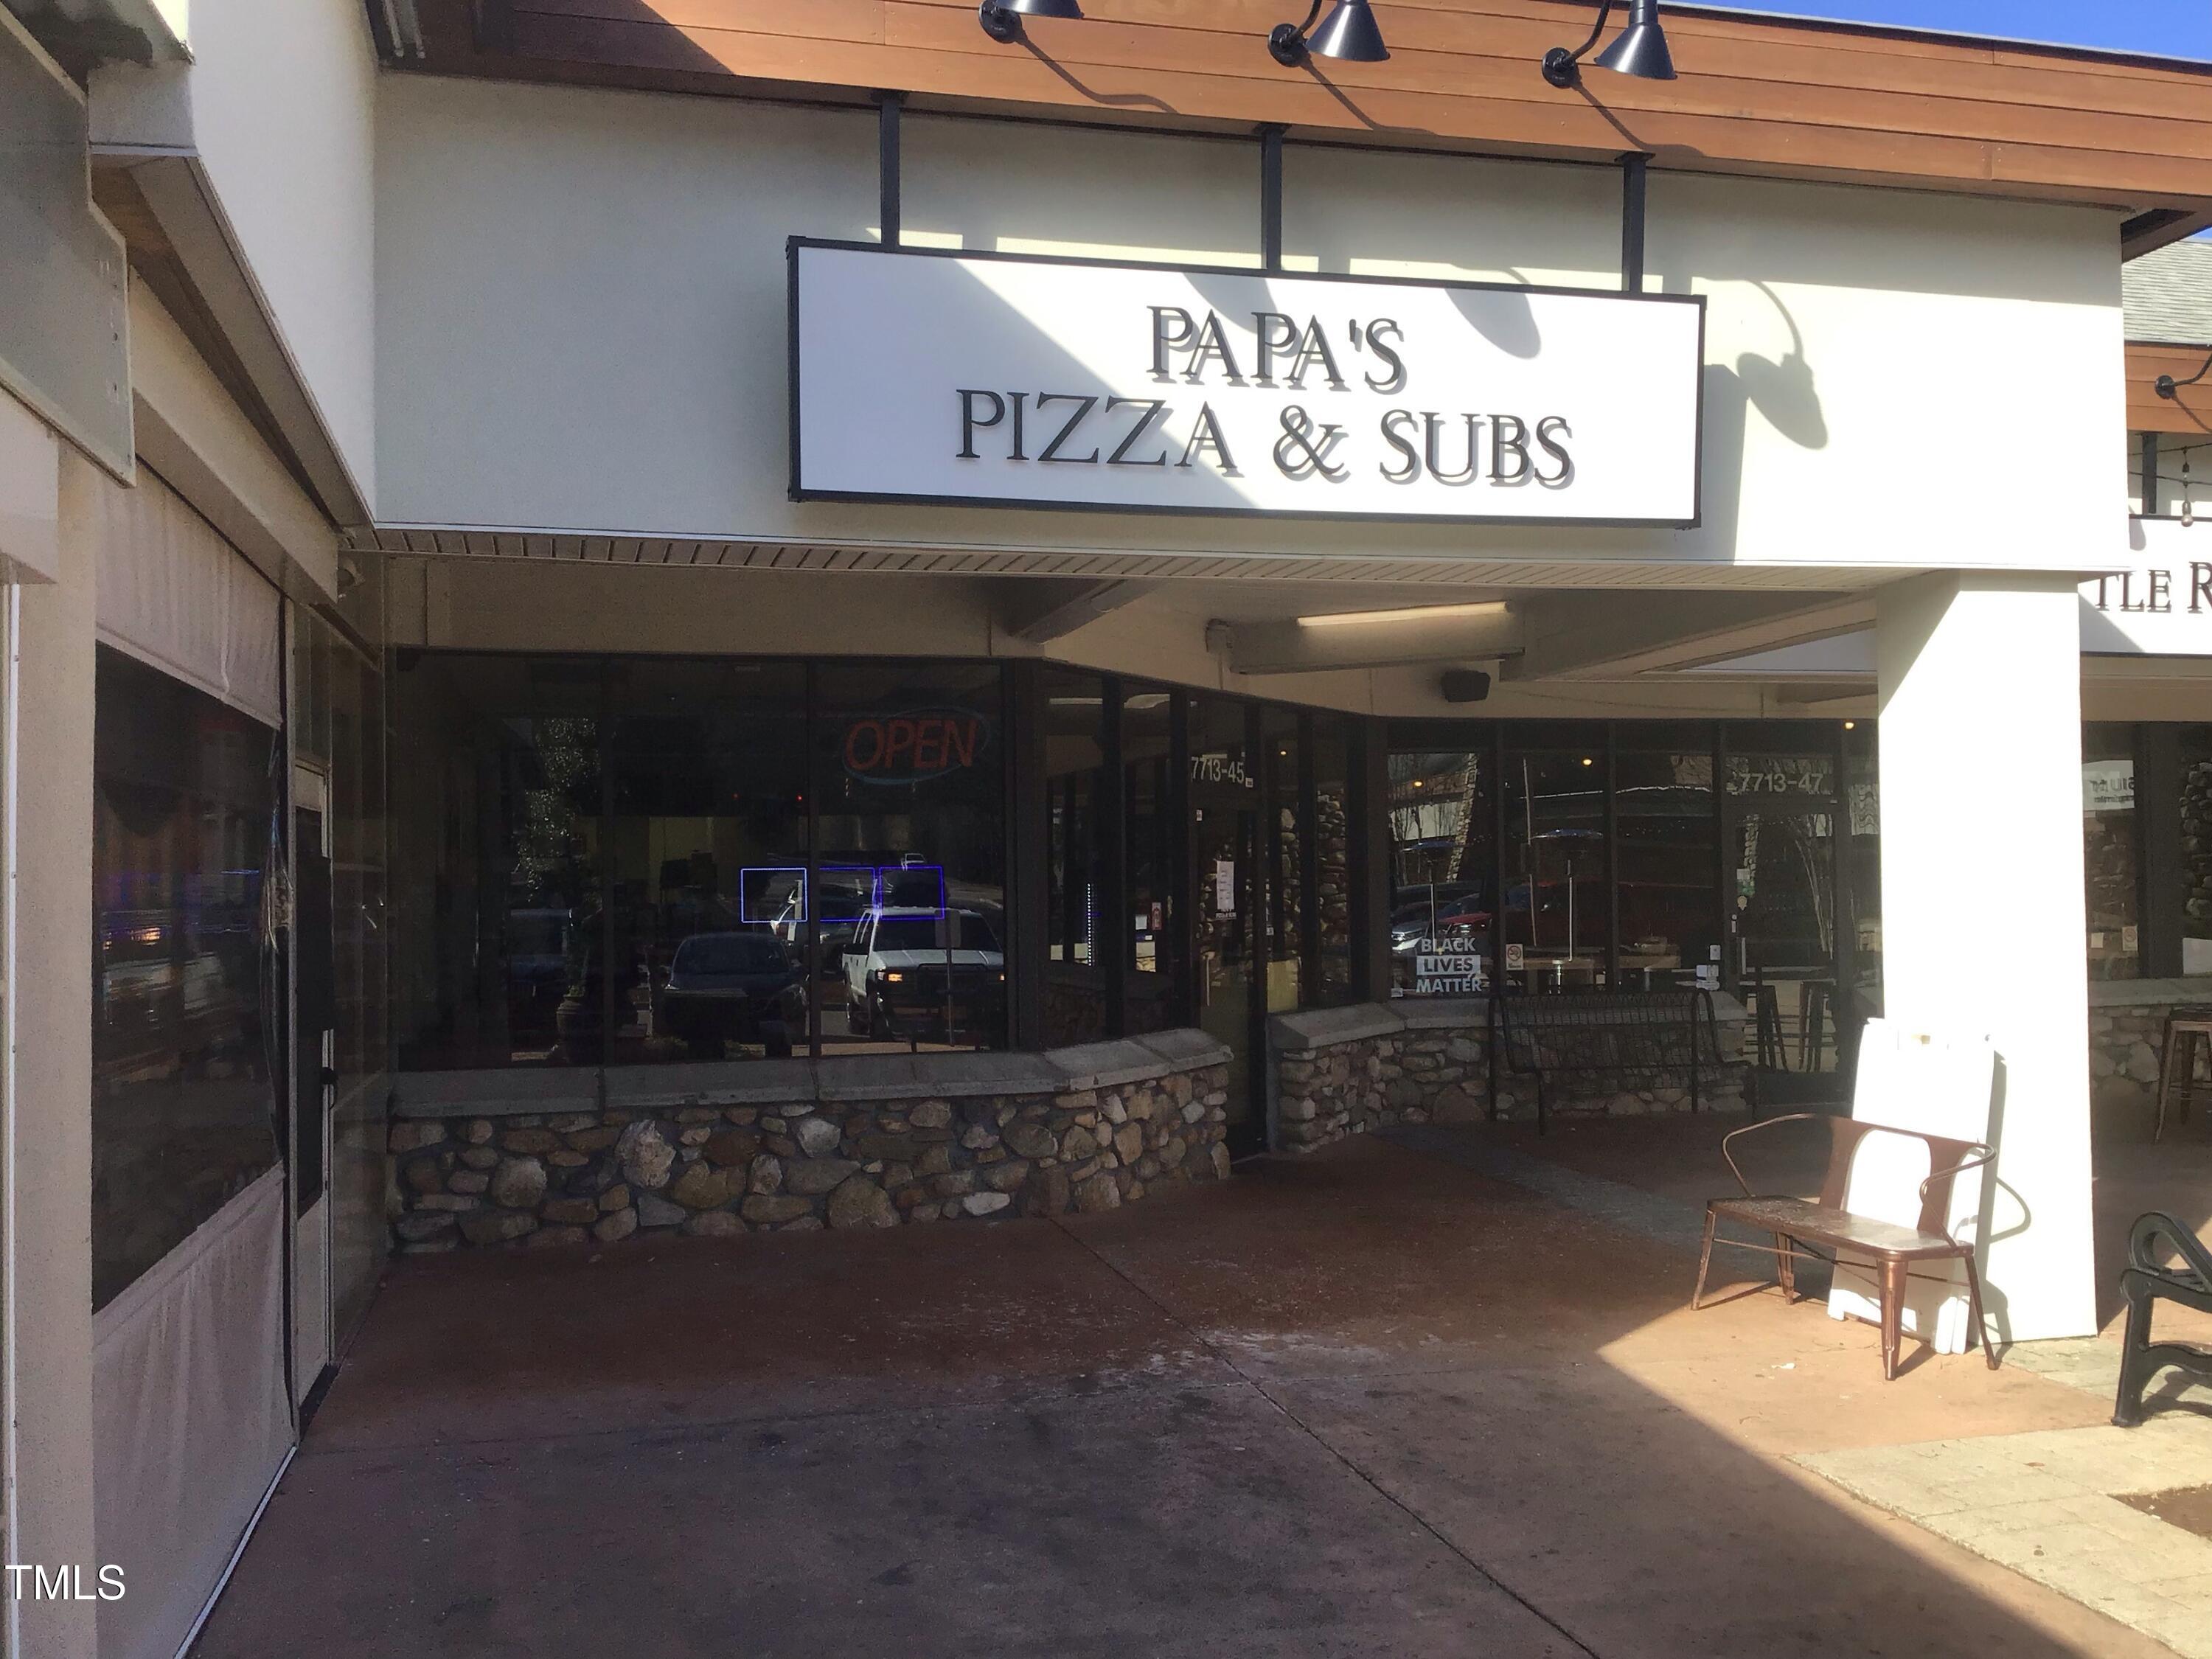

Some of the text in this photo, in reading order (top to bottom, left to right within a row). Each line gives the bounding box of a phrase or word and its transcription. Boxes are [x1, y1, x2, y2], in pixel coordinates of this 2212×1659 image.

[1147, 305, 1405, 388] PAPA'S
[955, 388, 1573, 484] PIZZA & SUBS
[845, 719, 979, 771] OPEN
[1191, 756, 1245, 784] 7713-45
[1740, 772, 1823, 793] 7713-47
[1421, 937, 1475, 953] BLACK
[1424, 957, 1473, 973] LIVES
[1416, 978, 1482, 993] MATTER
